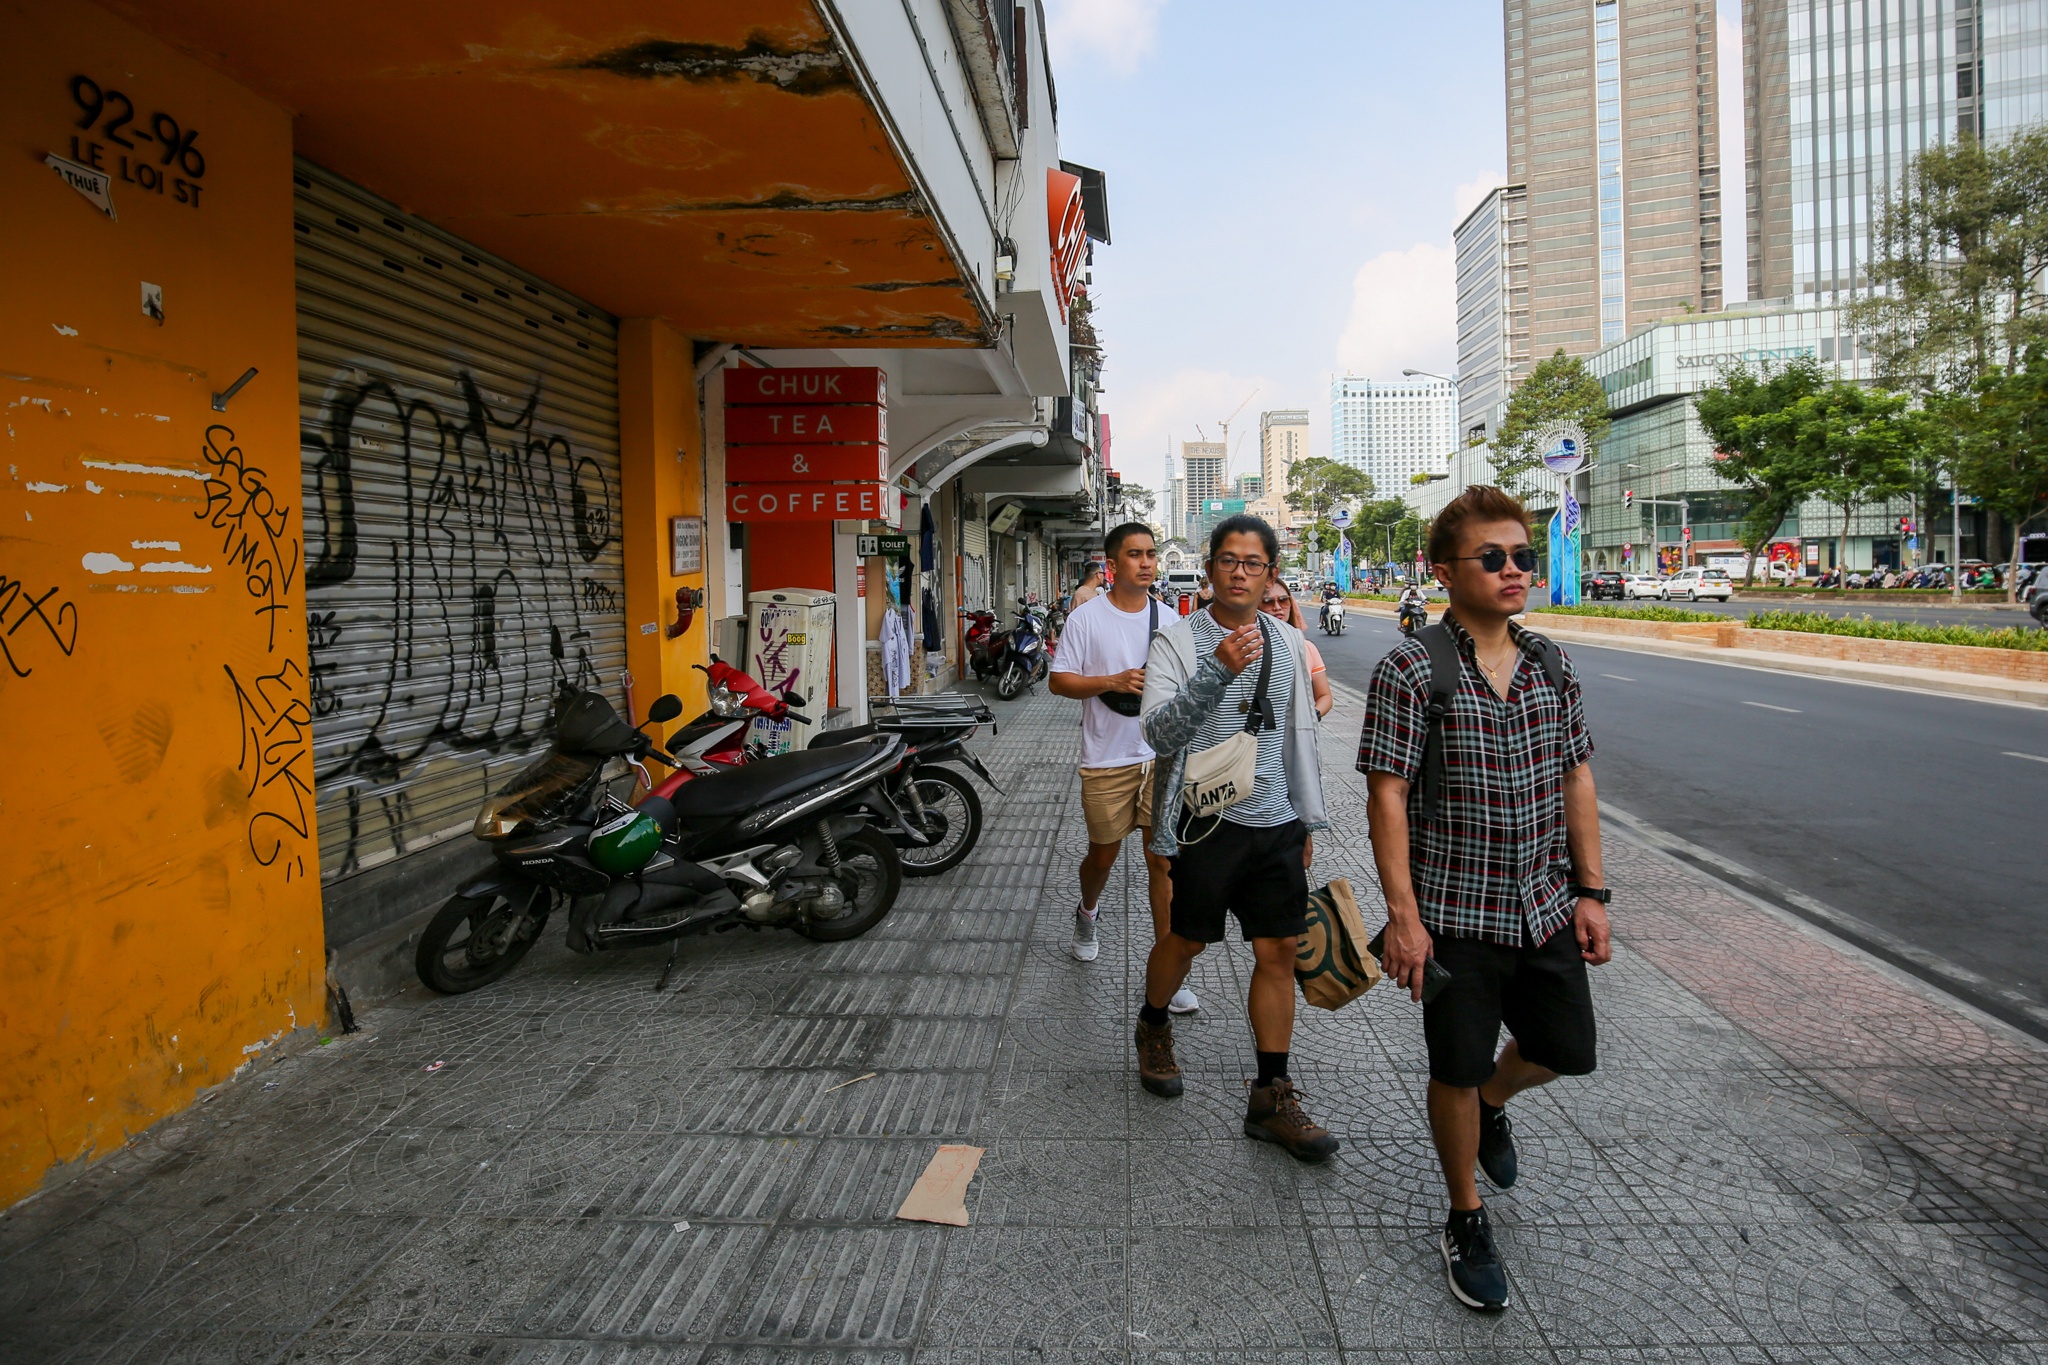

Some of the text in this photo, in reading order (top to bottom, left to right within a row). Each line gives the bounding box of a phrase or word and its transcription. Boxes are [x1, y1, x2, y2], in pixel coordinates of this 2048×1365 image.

[68, 74, 206, 179] 92-96
[71, 135, 204, 209] LE LOI ST
[65, 171, 102, 196] THUÊ
[758, 374, 842, 396] CHUK
[768, 414, 834, 435] TEA
[1190, 446, 1221, 455] THE NEXUS
[791, 453, 810, 474] &
[732, 491, 874, 514] COFFEE
[880, 541, 906, 549] TOILET
[787, 633, 806, 645] Boog
[1200, 780, 1238, 806] ANTA
[521, 857, 555, 866] HONDA
